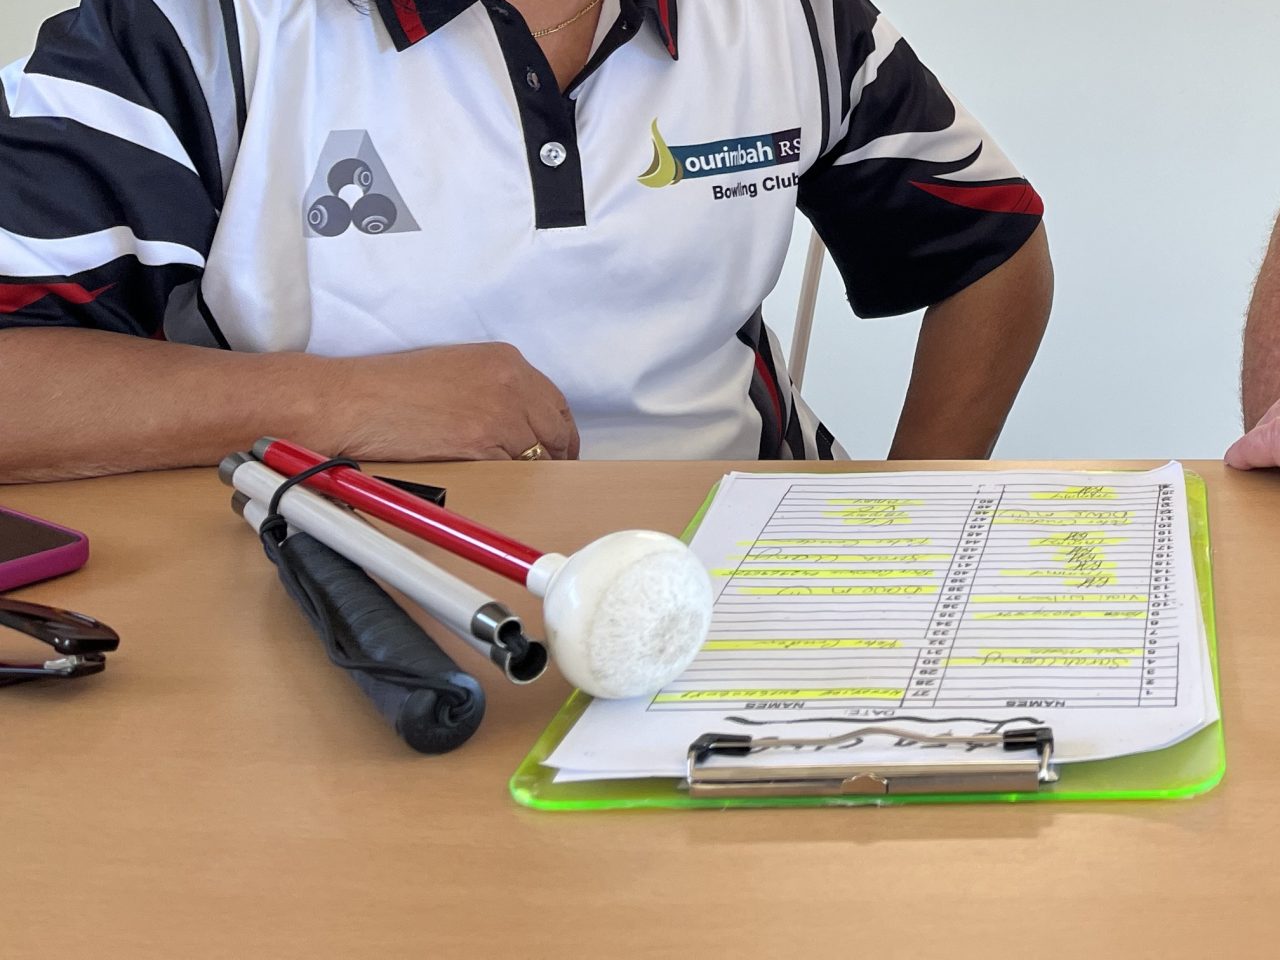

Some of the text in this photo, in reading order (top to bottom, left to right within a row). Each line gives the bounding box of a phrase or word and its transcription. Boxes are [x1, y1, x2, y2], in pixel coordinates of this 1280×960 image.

[685, 141, 773, 172] ourimbah
[712, 172, 800, 200] Bowling Club
